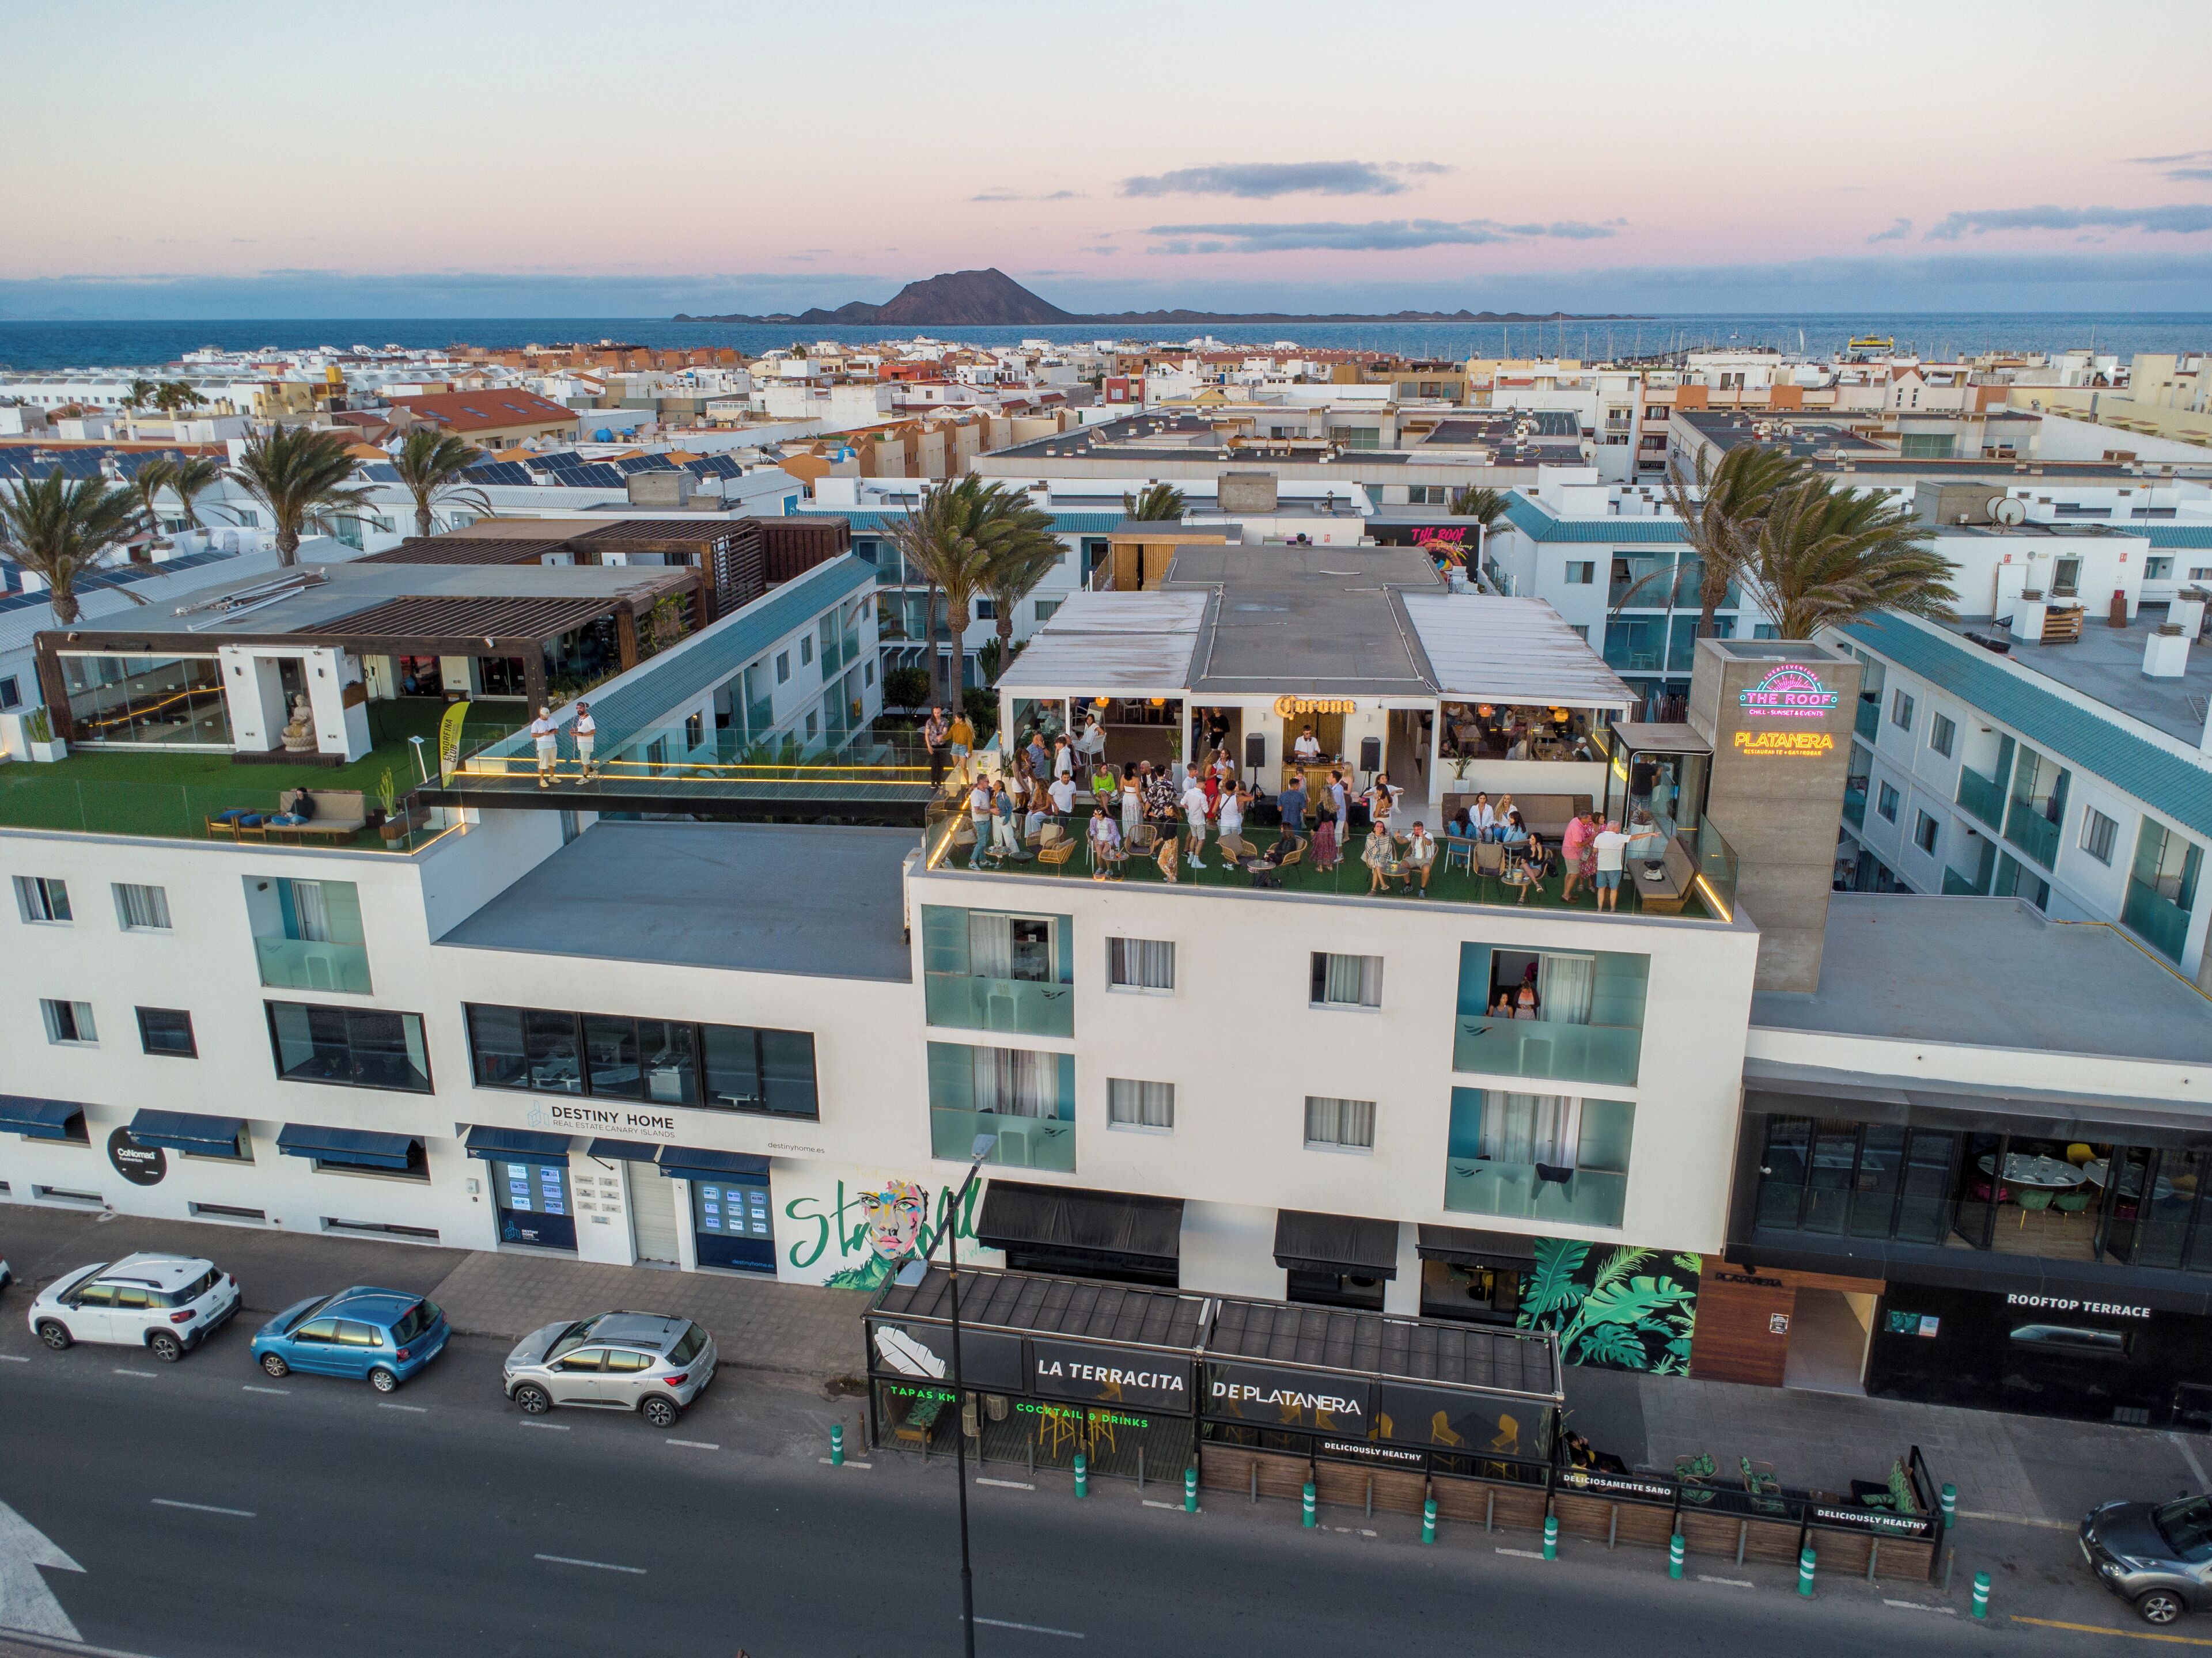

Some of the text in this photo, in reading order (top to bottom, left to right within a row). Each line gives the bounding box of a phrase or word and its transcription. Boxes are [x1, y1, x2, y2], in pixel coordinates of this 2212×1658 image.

[1411, 527, 1467, 543] THE ROOF
[1274, 695, 1357, 720] Corona
[1747, 693, 1831, 705] THE ROOF
[443, 719, 453, 761] ENDORFINA
[1734, 732, 1834, 749] PLATANERA
[449, 745, 457, 762] CLUB
[552, 1106, 674, 1129] DESTINY HOME
[576, 1122, 604, 1130] ESTATE
[605, 1125, 638, 1135] CANARY
[641, 1129, 675, 1138] ISLANDS
[118, 1148, 155, 1159] CoNomad
[768, 1141, 825, 1154] destinyhome.es
[732, 1259, 774, 1269] destinyhome.es
[2008, 1293, 2151, 1318] ROOFTOP TERRACE
[1038, 1360, 1184, 1391] LA TERRACITA
[891, 1386, 933, 1399] TAPAS
[1212, 1382, 1361, 1415] DE PLATANERA
[1016, 1403, 1083, 1419] COCKTAIL
[1102, 1414, 1148, 1428] DRINKS
[1325, 1442, 1422, 1461] DELICIOUSLY HEALTHY
[1563, 1474, 1671, 1495] DELICIOSAMENTE SANO
[1817, 1509, 1927, 1530] DELICIOUSLY HEALTHY
